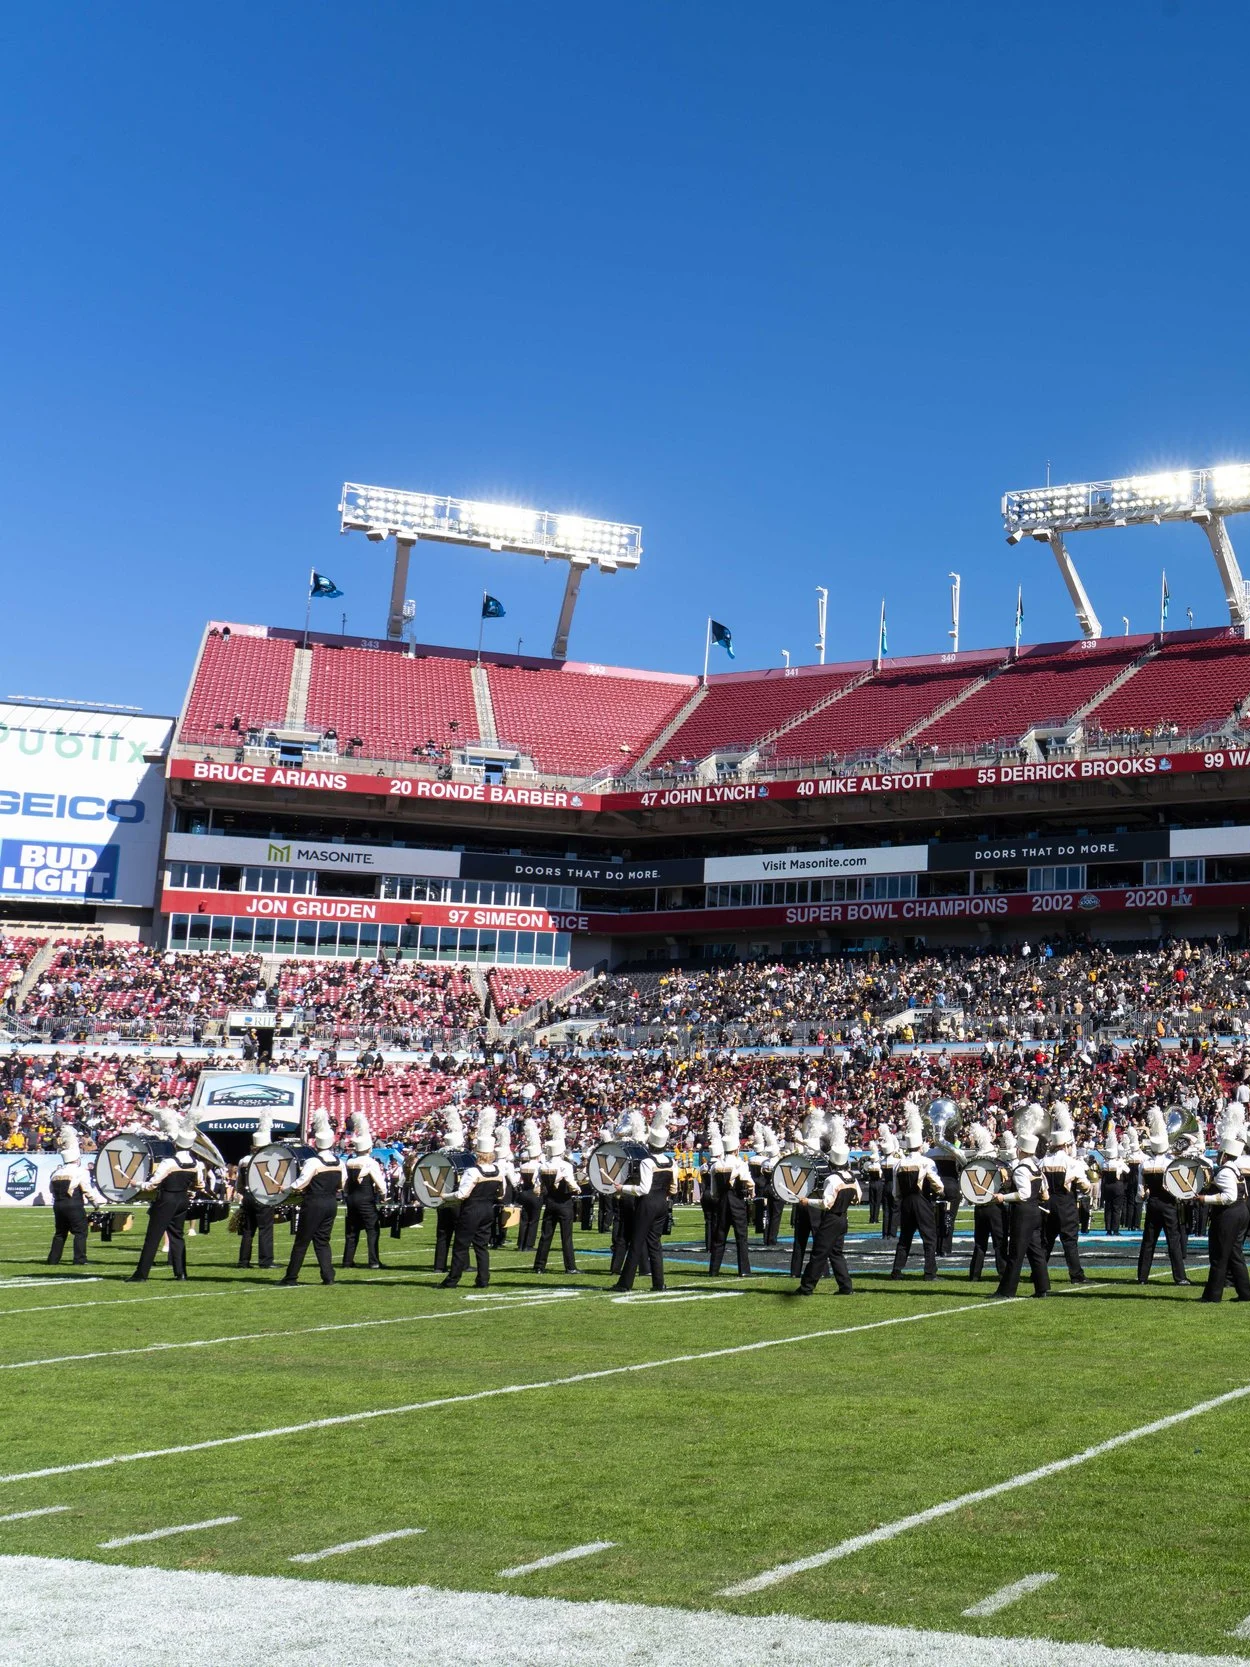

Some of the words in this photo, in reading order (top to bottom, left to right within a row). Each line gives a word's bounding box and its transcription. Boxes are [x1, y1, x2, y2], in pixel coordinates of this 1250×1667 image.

[361, 639, 379, 648] 343
[1081, 640, 1096, 649] 339
[942, 654, 956, 662] 340
[785, 668, 799, 676] 341
[978, 769, 996, 783] 55
[1001, 763, 1076, 782] DERRICK
[1081, 757, 1156, 777] BROOKS
[1204, 753, 1224, 769] 99
[194, 762, 268, 784] BRUCE
[271, 766, 347, 789] ARIANS
[797, 782, 814, 795] 40
[818, 779, 857, 794] MIKE
[861, 773, 933, 792] ALSTOTT
[391, 780, 412, 795] 20
[417, 782, 485, 802] RONDÉ
[491, 788, 567, 807] BARBER
[641, 792, 656, 806] 47
[661, 789, 702, 804] JOHN
[707, 786, 755, 802] LYNCH
[20, 844, 98, 870] BUD
[762, 860, 786, 871] Visit
[790, 856, 867, 870] Masonite.com
[975, 850, 1016, 859] DOORS
[1022, 848, 1052, 857] THAT
[1058, 846, 1074, 855] DO
[2, 867, 110, 893] LIGHT
[515, 866, 561, 876] DOORS
[568, 869, 600, 878] THAT
[606, 871, 624, 880] DO
[246, 899, 287, 915] JON
[293, 901, 376, 919] GRUDEN
[786, 906, 842, 923] SUPER
[848, 904, 898, 920] BOWL
[902, 898, 1008, 918] CHAMPIONS
[1032, 895, 1073, 911] 2002
[1125, 890, 1168, 907] 2020
[448, 910, 469, 924] 97
[473, 911, 543, 929] SIMEON
[548, 915, 589, 931] RICE
[105, 1149, 148, 1189] V
[254, 1158, 292, 1195] V
[419, 1166, 451, 1197] V
[596, 1154, 627, 1185] V
[780, 1166, 813, 1195] V
[1168, 1169, 1198, 1194] V
[964, 1169, 997, 1198] V
